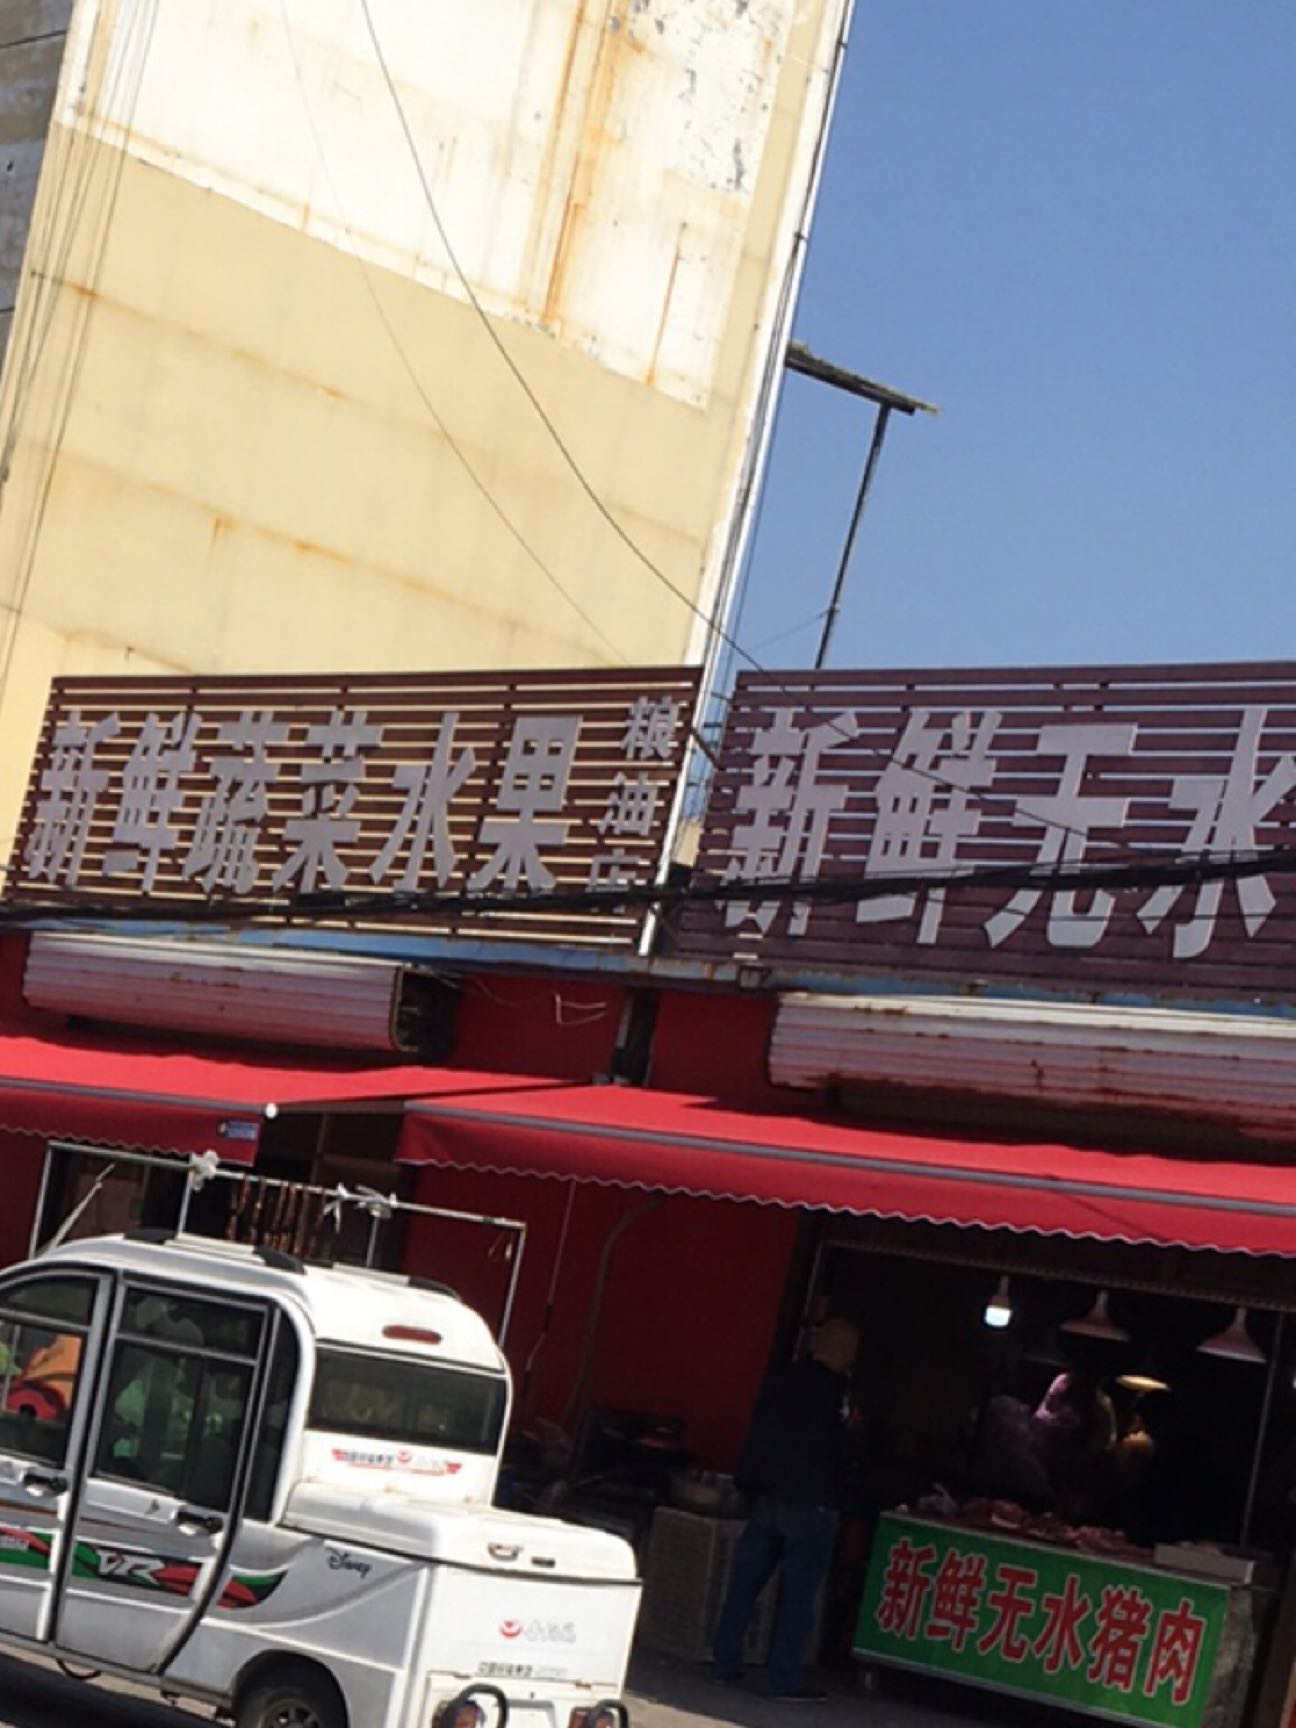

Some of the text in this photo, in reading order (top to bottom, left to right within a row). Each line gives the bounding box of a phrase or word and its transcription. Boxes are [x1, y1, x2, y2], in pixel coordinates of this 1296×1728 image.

[24, 710, 583, 894] 新鲜蔬菜水果
[584, 695, 680, 912] 粮油店
[719, 707, 1296, 959] 新鲜无水
[327, 1549, 372, 1579] Disney
[873, 1536, 1208, 1705] 新鲜无水猪肉
